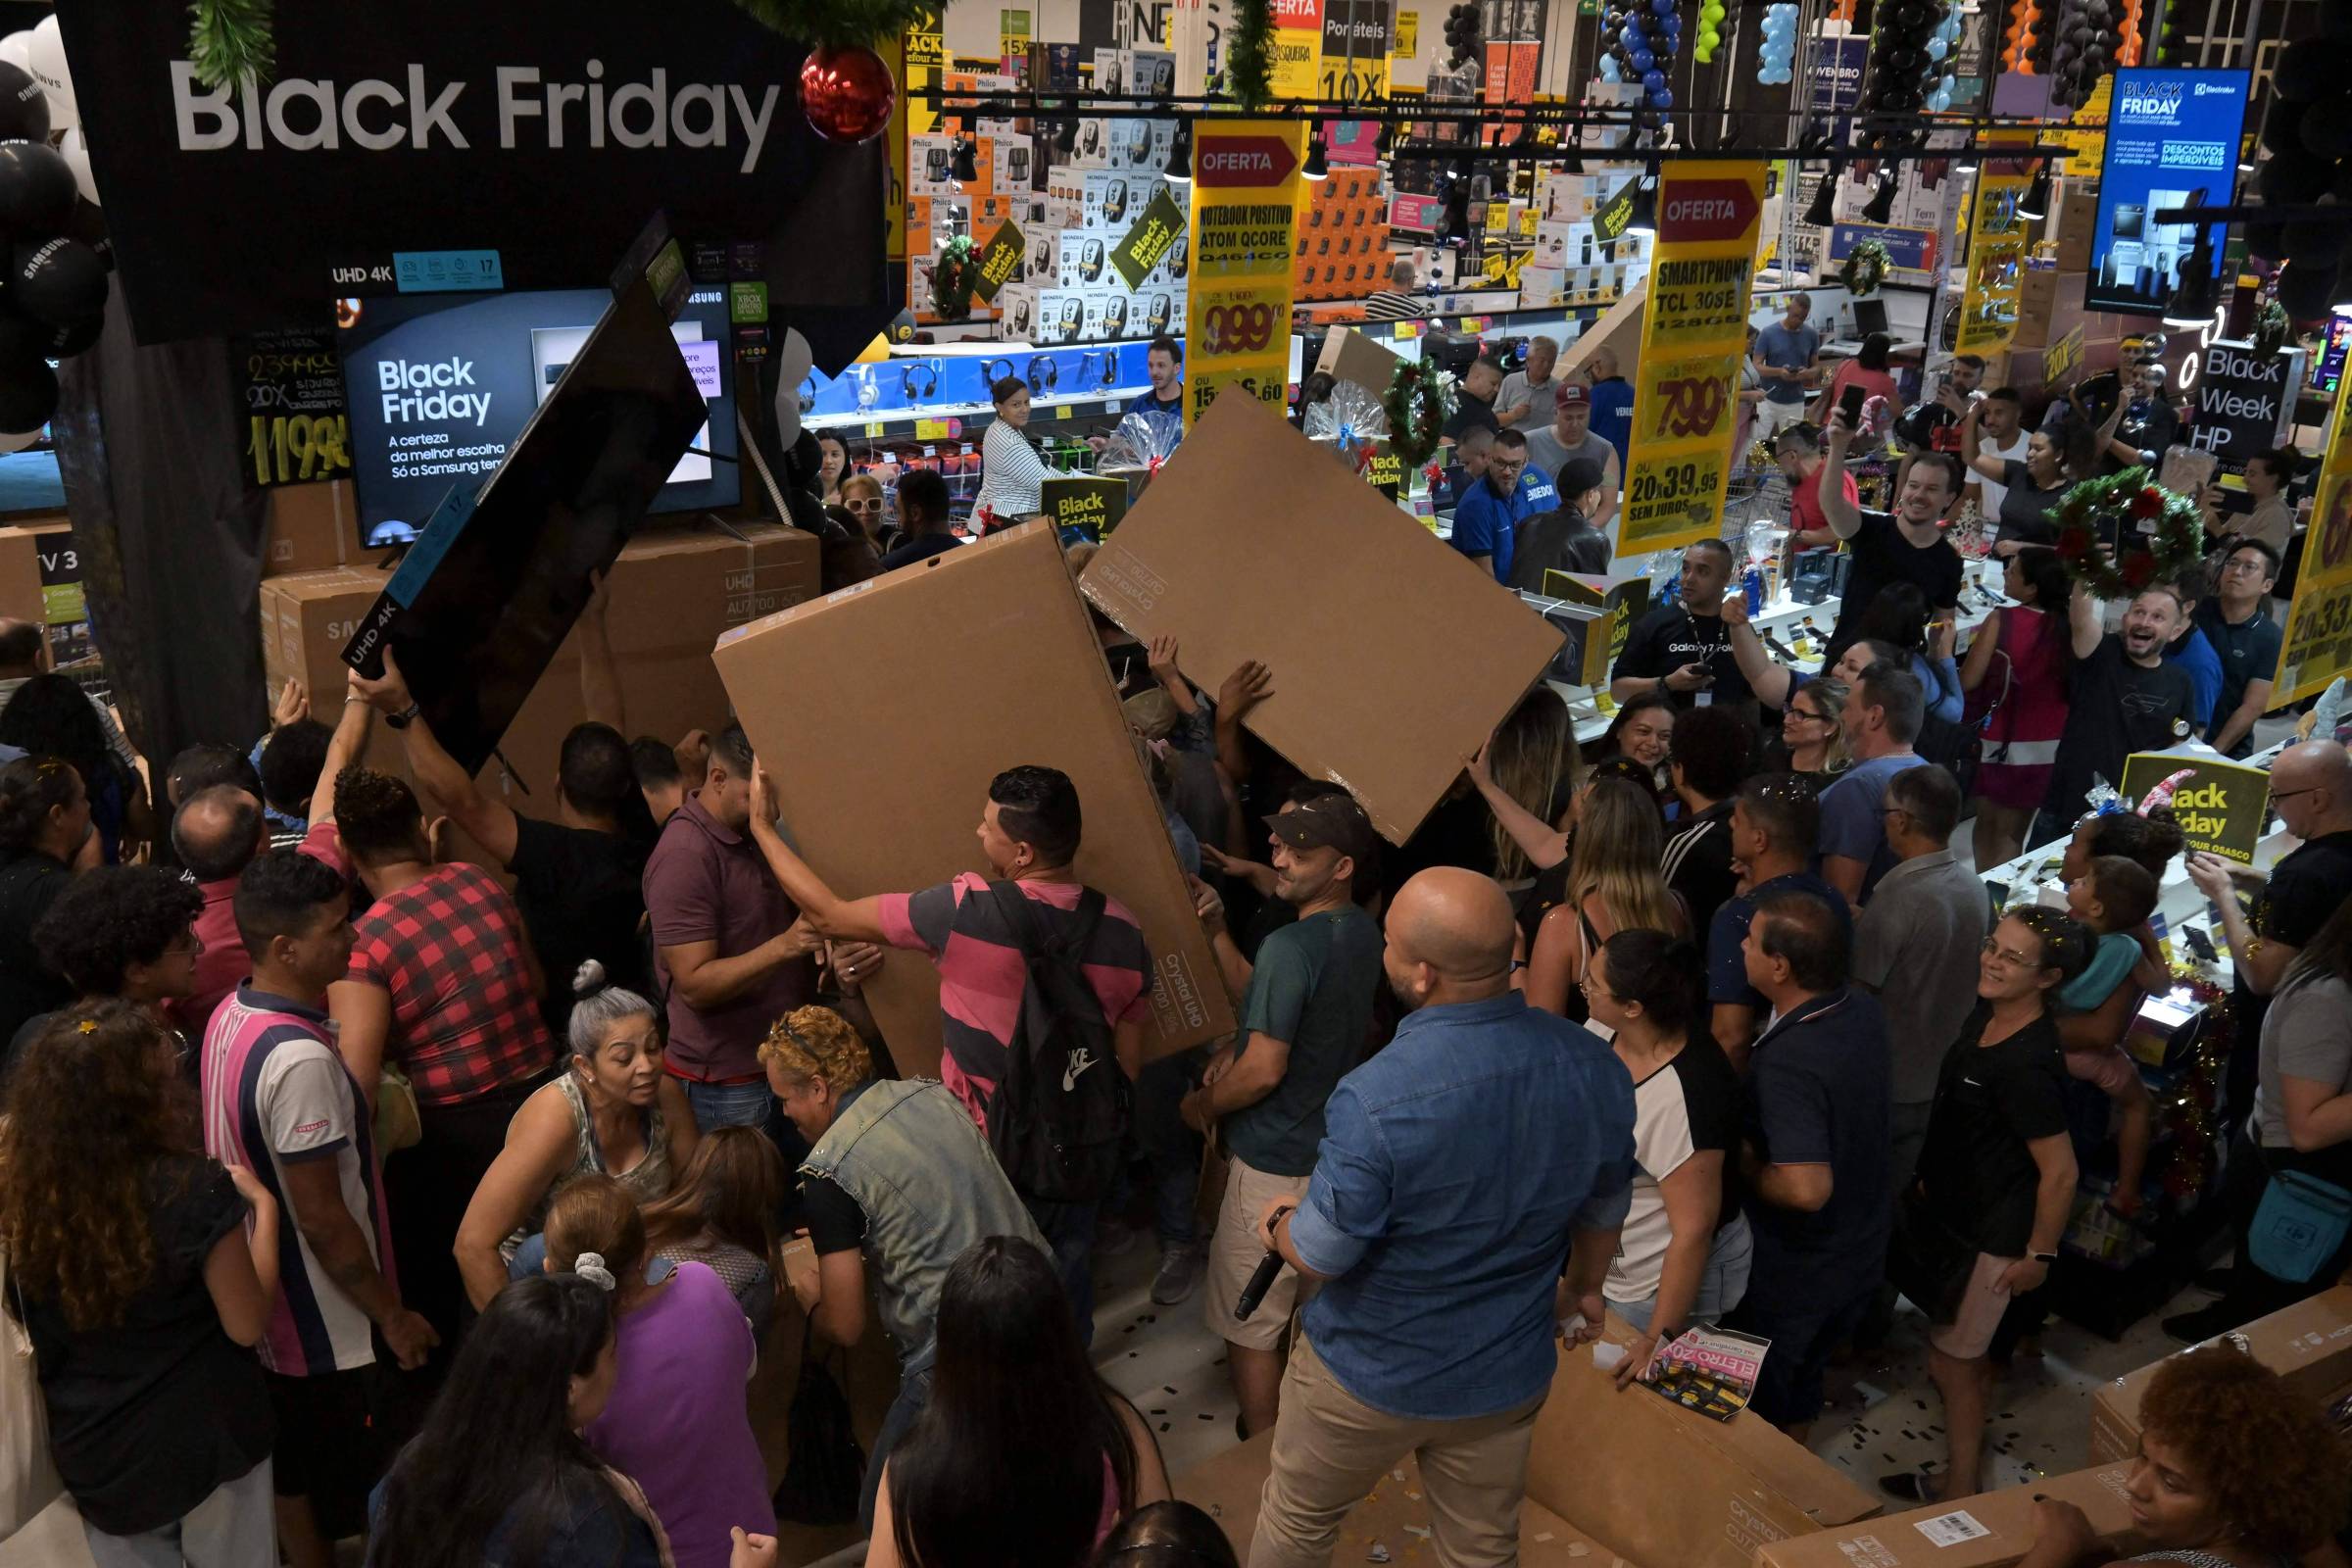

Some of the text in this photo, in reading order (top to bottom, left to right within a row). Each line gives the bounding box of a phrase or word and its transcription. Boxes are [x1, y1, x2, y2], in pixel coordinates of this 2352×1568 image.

[1327, 20, 1385, 38] Poráteis
[1323, 71, 1380, 102] 10X
[2124, 81, 2184, 99] BLACK
[170, 57, 782, 173] Black Friday
[2120, 98, 2182, 116] FRIDAY
[912, 139, 932, 149] Philco
[994, 139, 1013, 150] Philco
[2162, 144, 2226, 156] DESCONTOS
[1202, 153, 1273, 172] OFERTA
[2160, 154, 2225, 166] IMPERDÍVEIS
[932, 199, 952, 209] Philco
[1011, 198, 1030, 208] Philco
[1605, 196, 1629, 228] Black
[1667, 198, 1736, 222] OFERTA
[1200, 204, 1292, 226] NOTEBOOK POSITIVO
[1130, 218, 1161, 262] Black
[1140, 225, 1171, 270] Friday
[1200, 230, 1286, 248] ATOM QCORE
[24, 236, 70, 280] SAMSUNG
[480, 259, 493, 272] 17
[914, 259, 934, 269] Philco
[981, 241, 1008, 279] Black
[992, 248, 1016, 286] Friday
[332, 266, 369, 284] UHD
[370, 266, 395, 283] 4K
[1658, 258, 1748, 287] SMARTPHONE
[1655, 293, 1689, 313] TCL
[377, 356, 476, 391] Black
[2205, 348, 2281, 383] Black
[1195, 376, 1209, 386] OU
[381, 389, 492, 426] Friday
[1194, 386, 1219, 408] 15
[2202, 386, 2276, 422] Week
[389, 433, 450, 448] A certeza
[2190, 423, 2231, 452] HP
[391, 443, 506, 464] da melhor escolha
[391, 466, 409, 478] Só
[410, 466, 420, 477] a
[420, 458, 480, 475] Samsung
[1635, 462, 1651, 474] OU
[1057, 491, 1105, 516] Black
[1630, 498, 1690, 521] SEM JUROS
[62, 550, 78, 570] 3
[725, 573, 755, 591] UHD
[350, 601, 397, 664] UHD 4K
[2170, 782, 2228, 809] lack
[2174, 810, 2228, 840] day
[2211, 844, 2251, 861] OSASCO
[1165, 953, 1204, 1029] Crystal UHD
[1067, 1048, 1089, 1071] KE
[1694, 1348, 1754, 1378] ELETRO
